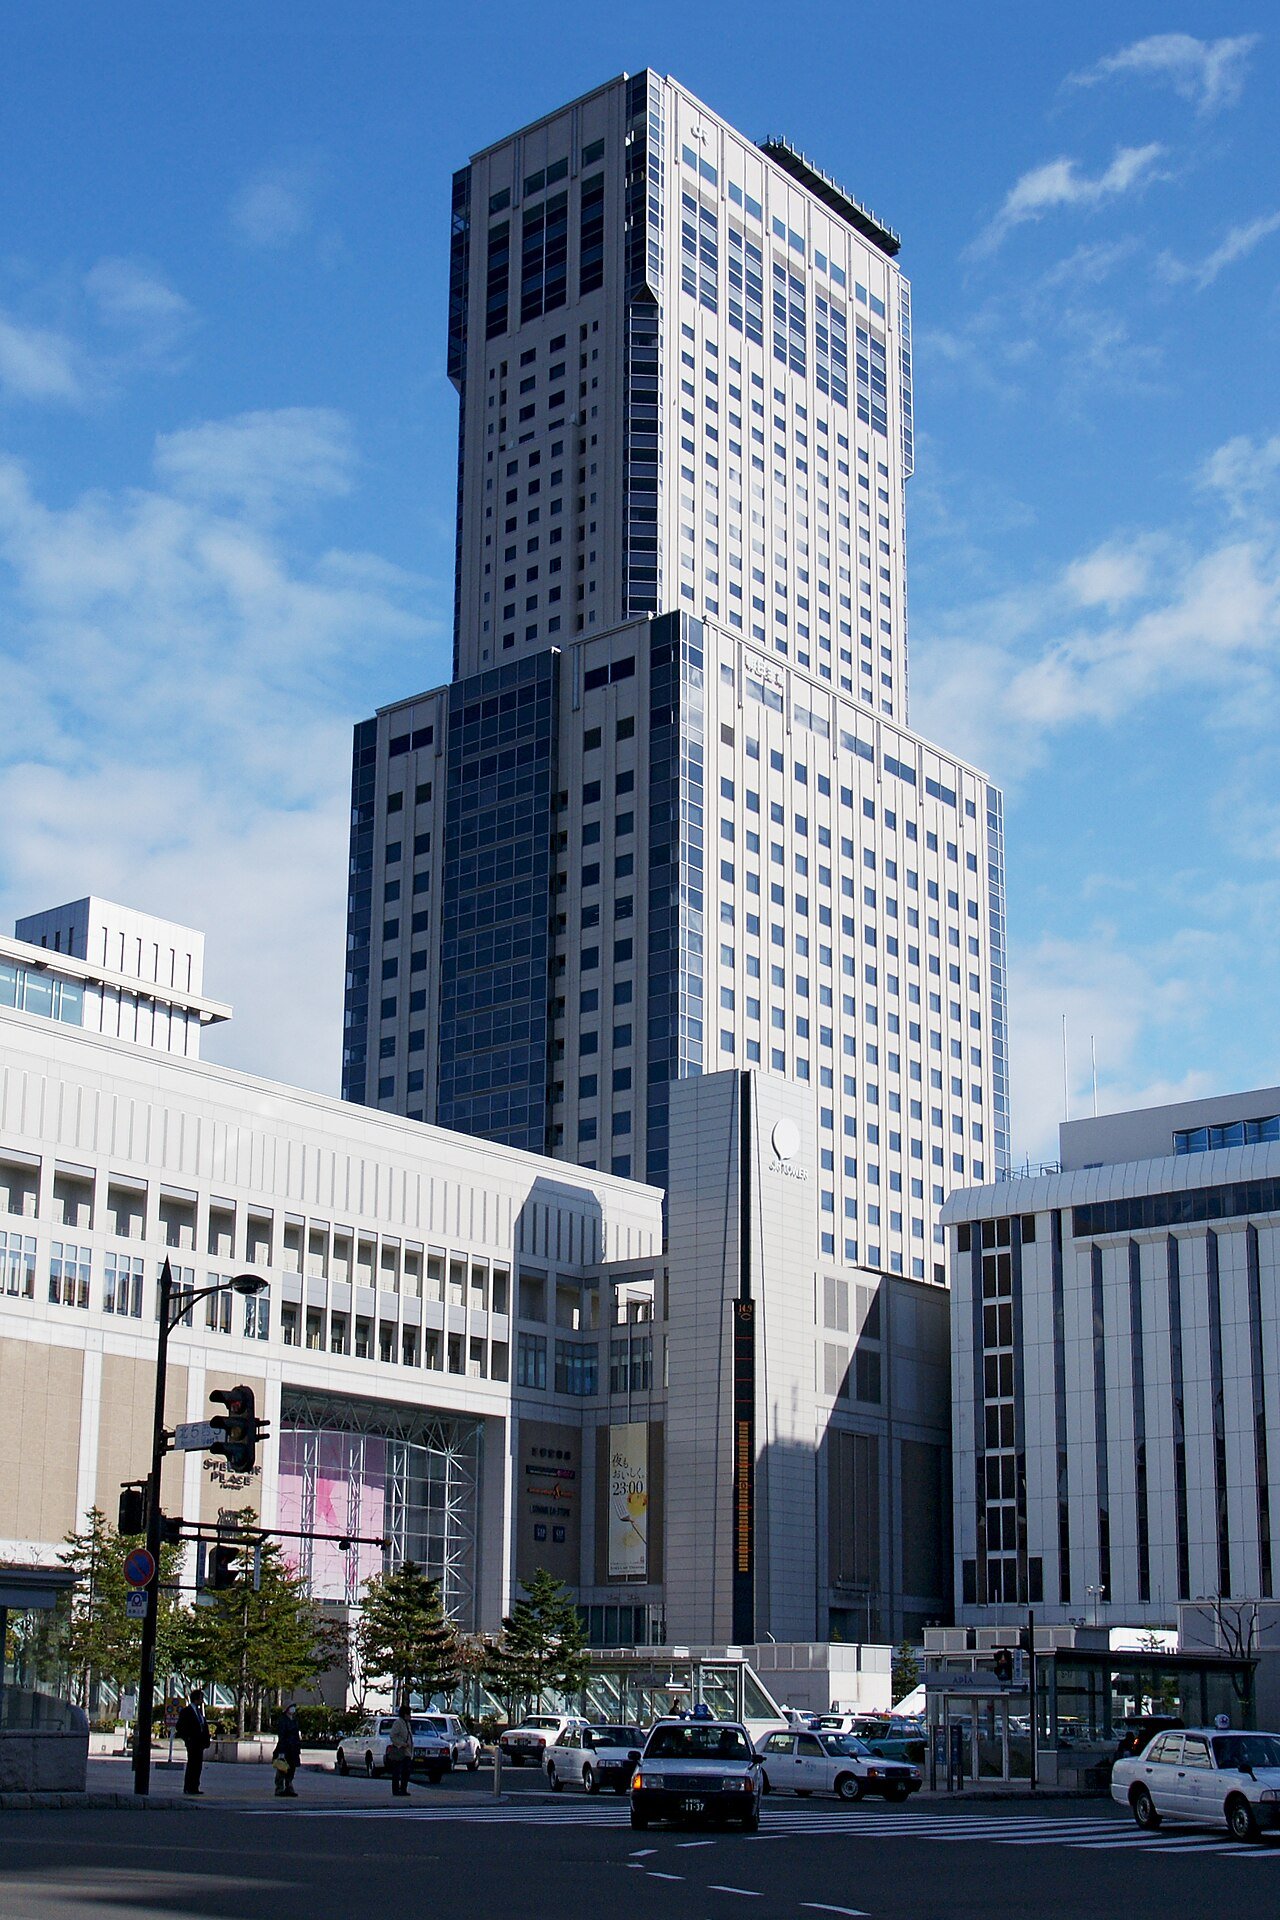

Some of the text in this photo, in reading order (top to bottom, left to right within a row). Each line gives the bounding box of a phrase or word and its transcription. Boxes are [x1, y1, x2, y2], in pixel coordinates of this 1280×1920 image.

[203, 1458, 262, 1476] STELR
[612, 1452, 629, 1469] 夜も
[210, 1472, 253, 1486] PLACE
[612, 1480, 644, 1496] 23:00
